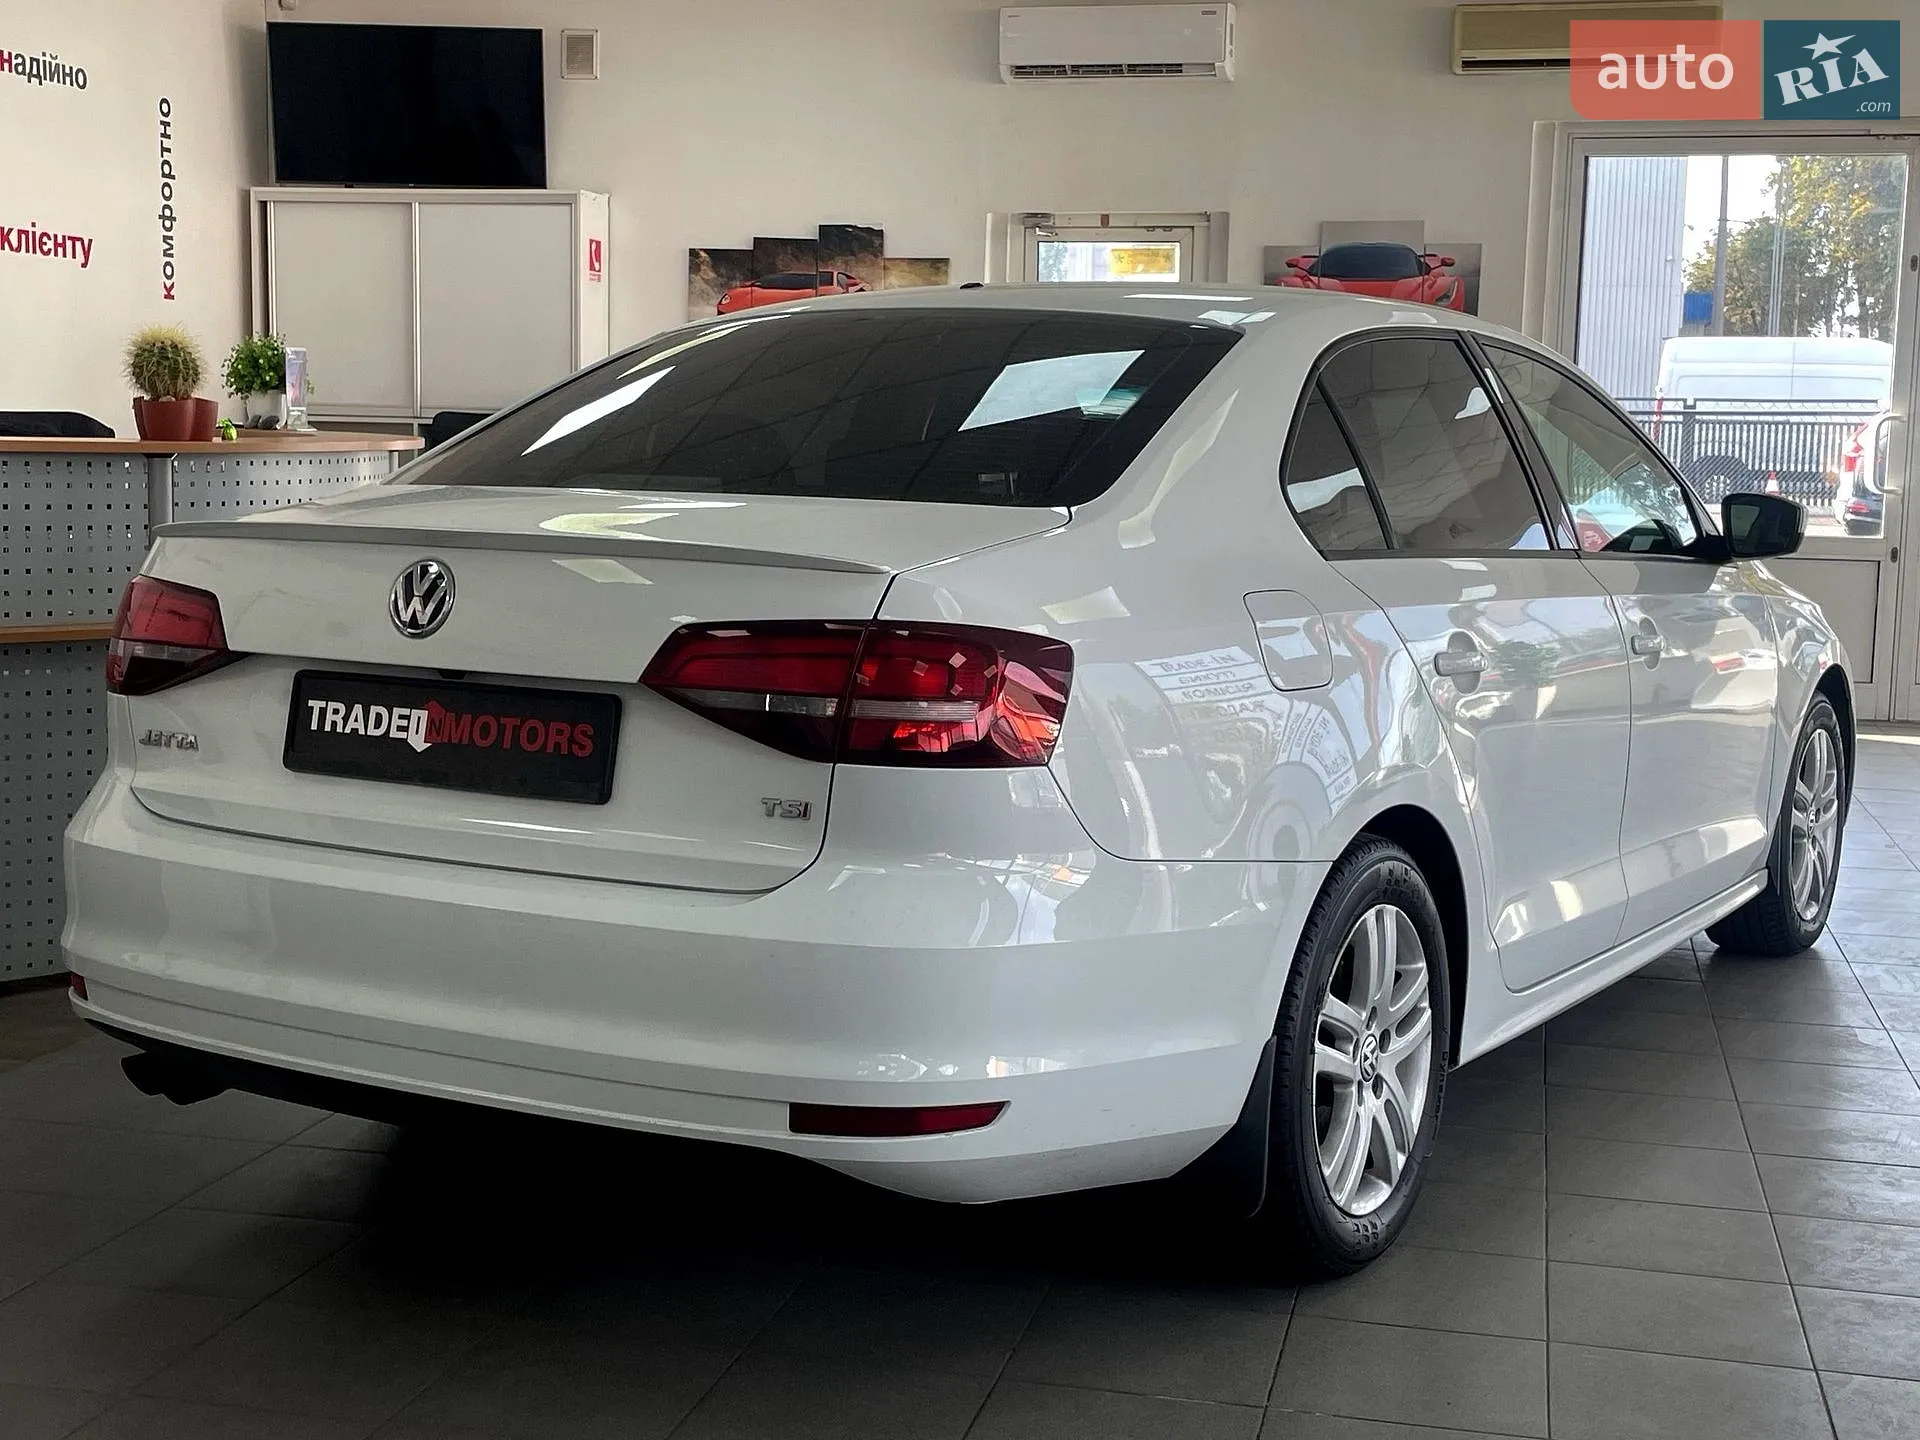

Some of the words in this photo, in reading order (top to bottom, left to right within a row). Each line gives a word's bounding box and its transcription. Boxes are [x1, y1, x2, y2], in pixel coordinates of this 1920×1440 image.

[0, 50, 88, 90] надійно
[158, 97, 177, 301] комфортно
[0, 221, 94, 269] клієнту
[138, 729, 199, 752] JETTA
[445, 712, 594, 758] MOTORS
[761, 797, 812, 821] TSI
